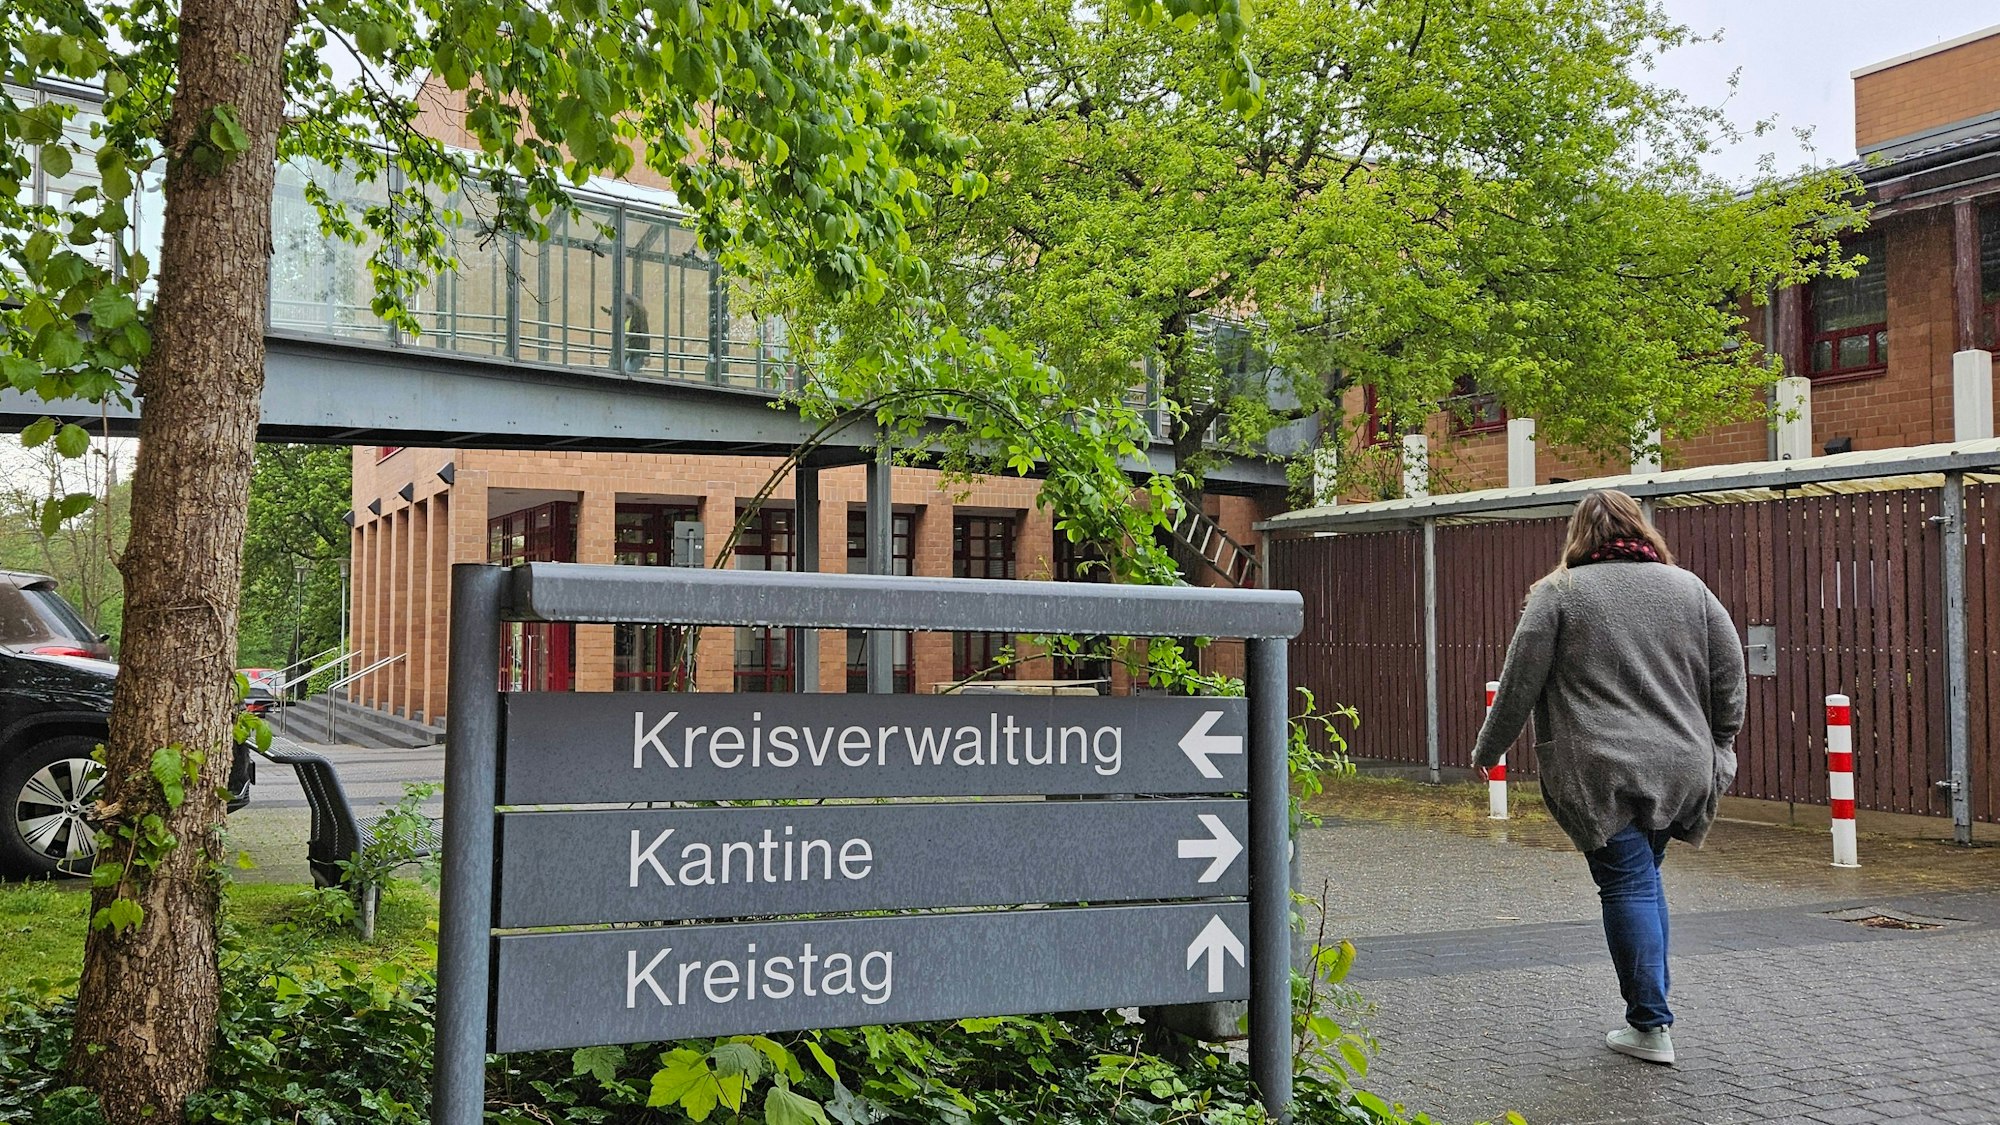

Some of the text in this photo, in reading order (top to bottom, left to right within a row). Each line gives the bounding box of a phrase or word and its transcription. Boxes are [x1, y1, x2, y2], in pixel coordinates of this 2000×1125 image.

[633, 711, 1122, 776] Kreisverwaltung
[629, 825, 873, 888] Kantine
[625, 943, 893, 1009] Kreistag
